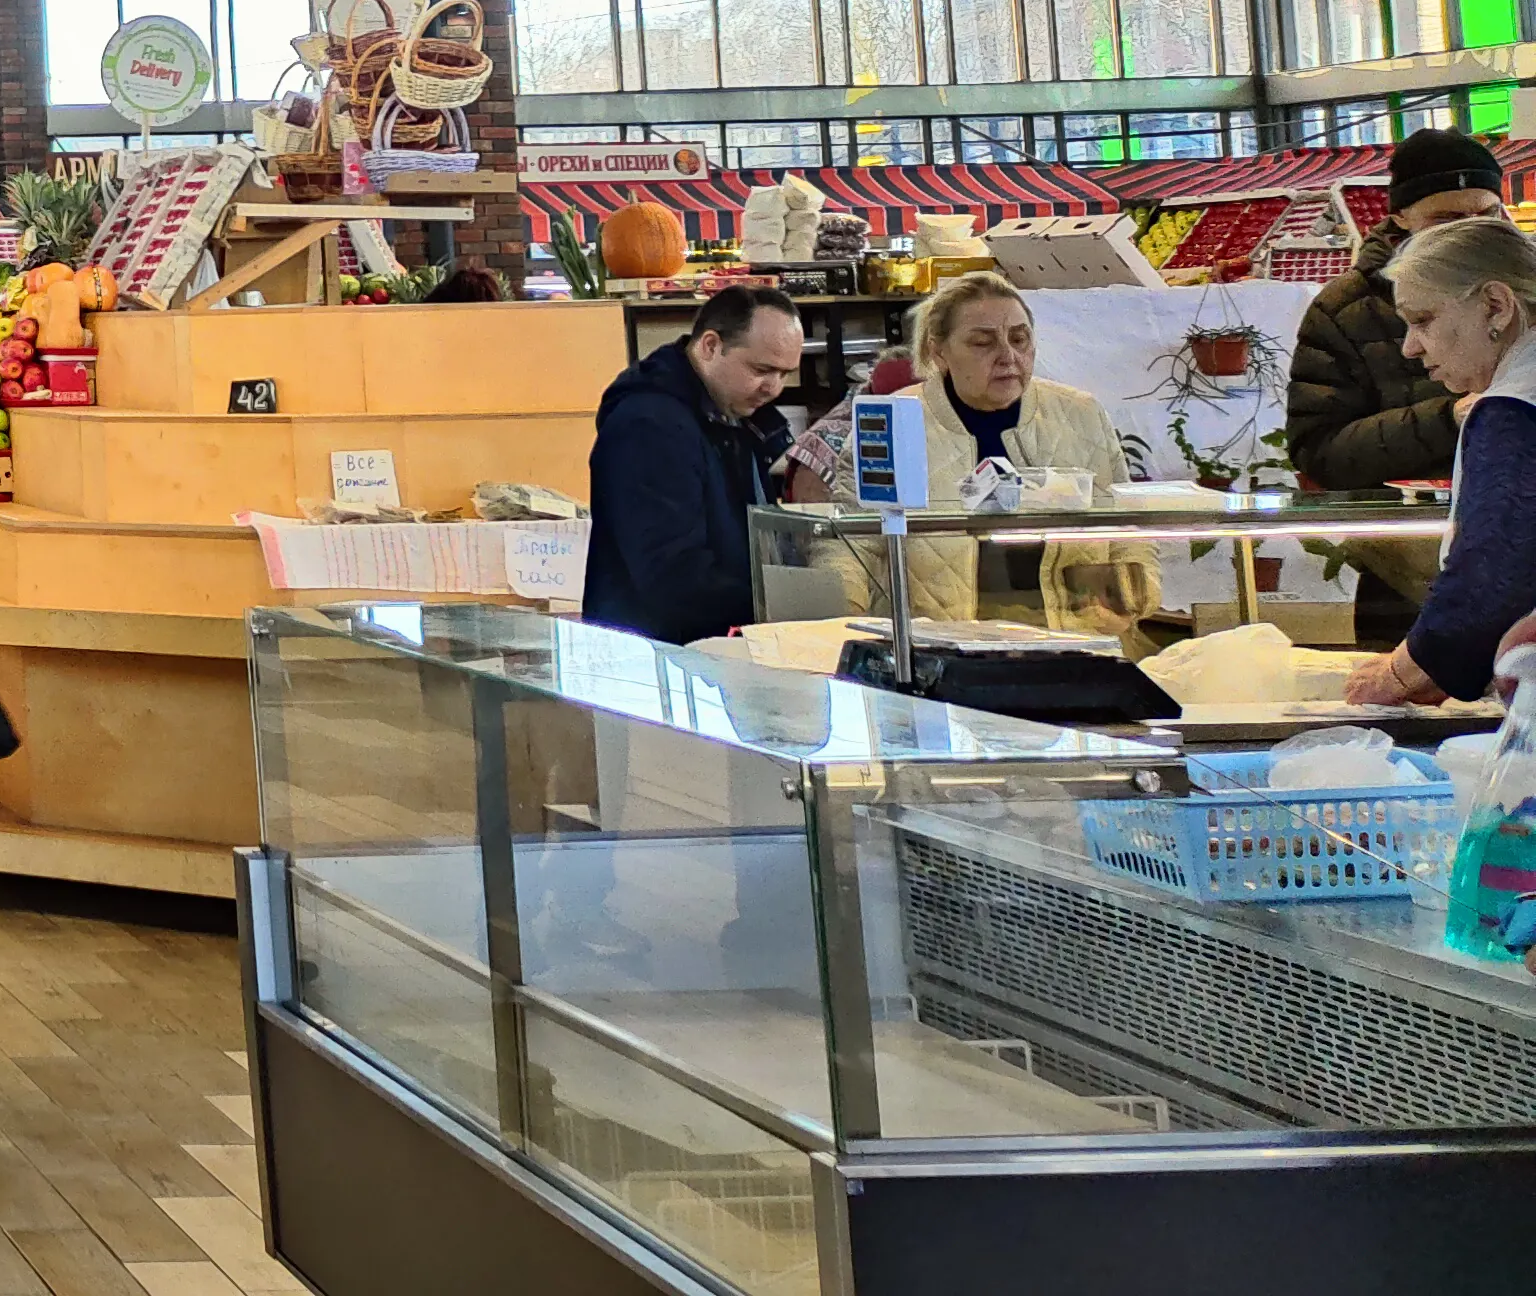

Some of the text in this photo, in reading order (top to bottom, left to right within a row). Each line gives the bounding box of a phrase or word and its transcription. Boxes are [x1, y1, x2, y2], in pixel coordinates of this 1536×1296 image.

[141, 43, 176, 64] Fresh
[129, 59, 183, 87] Delivery
[538, 155, 590, 172] ОРЕХИ
[605, 154, 670, 174] СПЕЦИИ
[236, 382, 269, 411] 42
